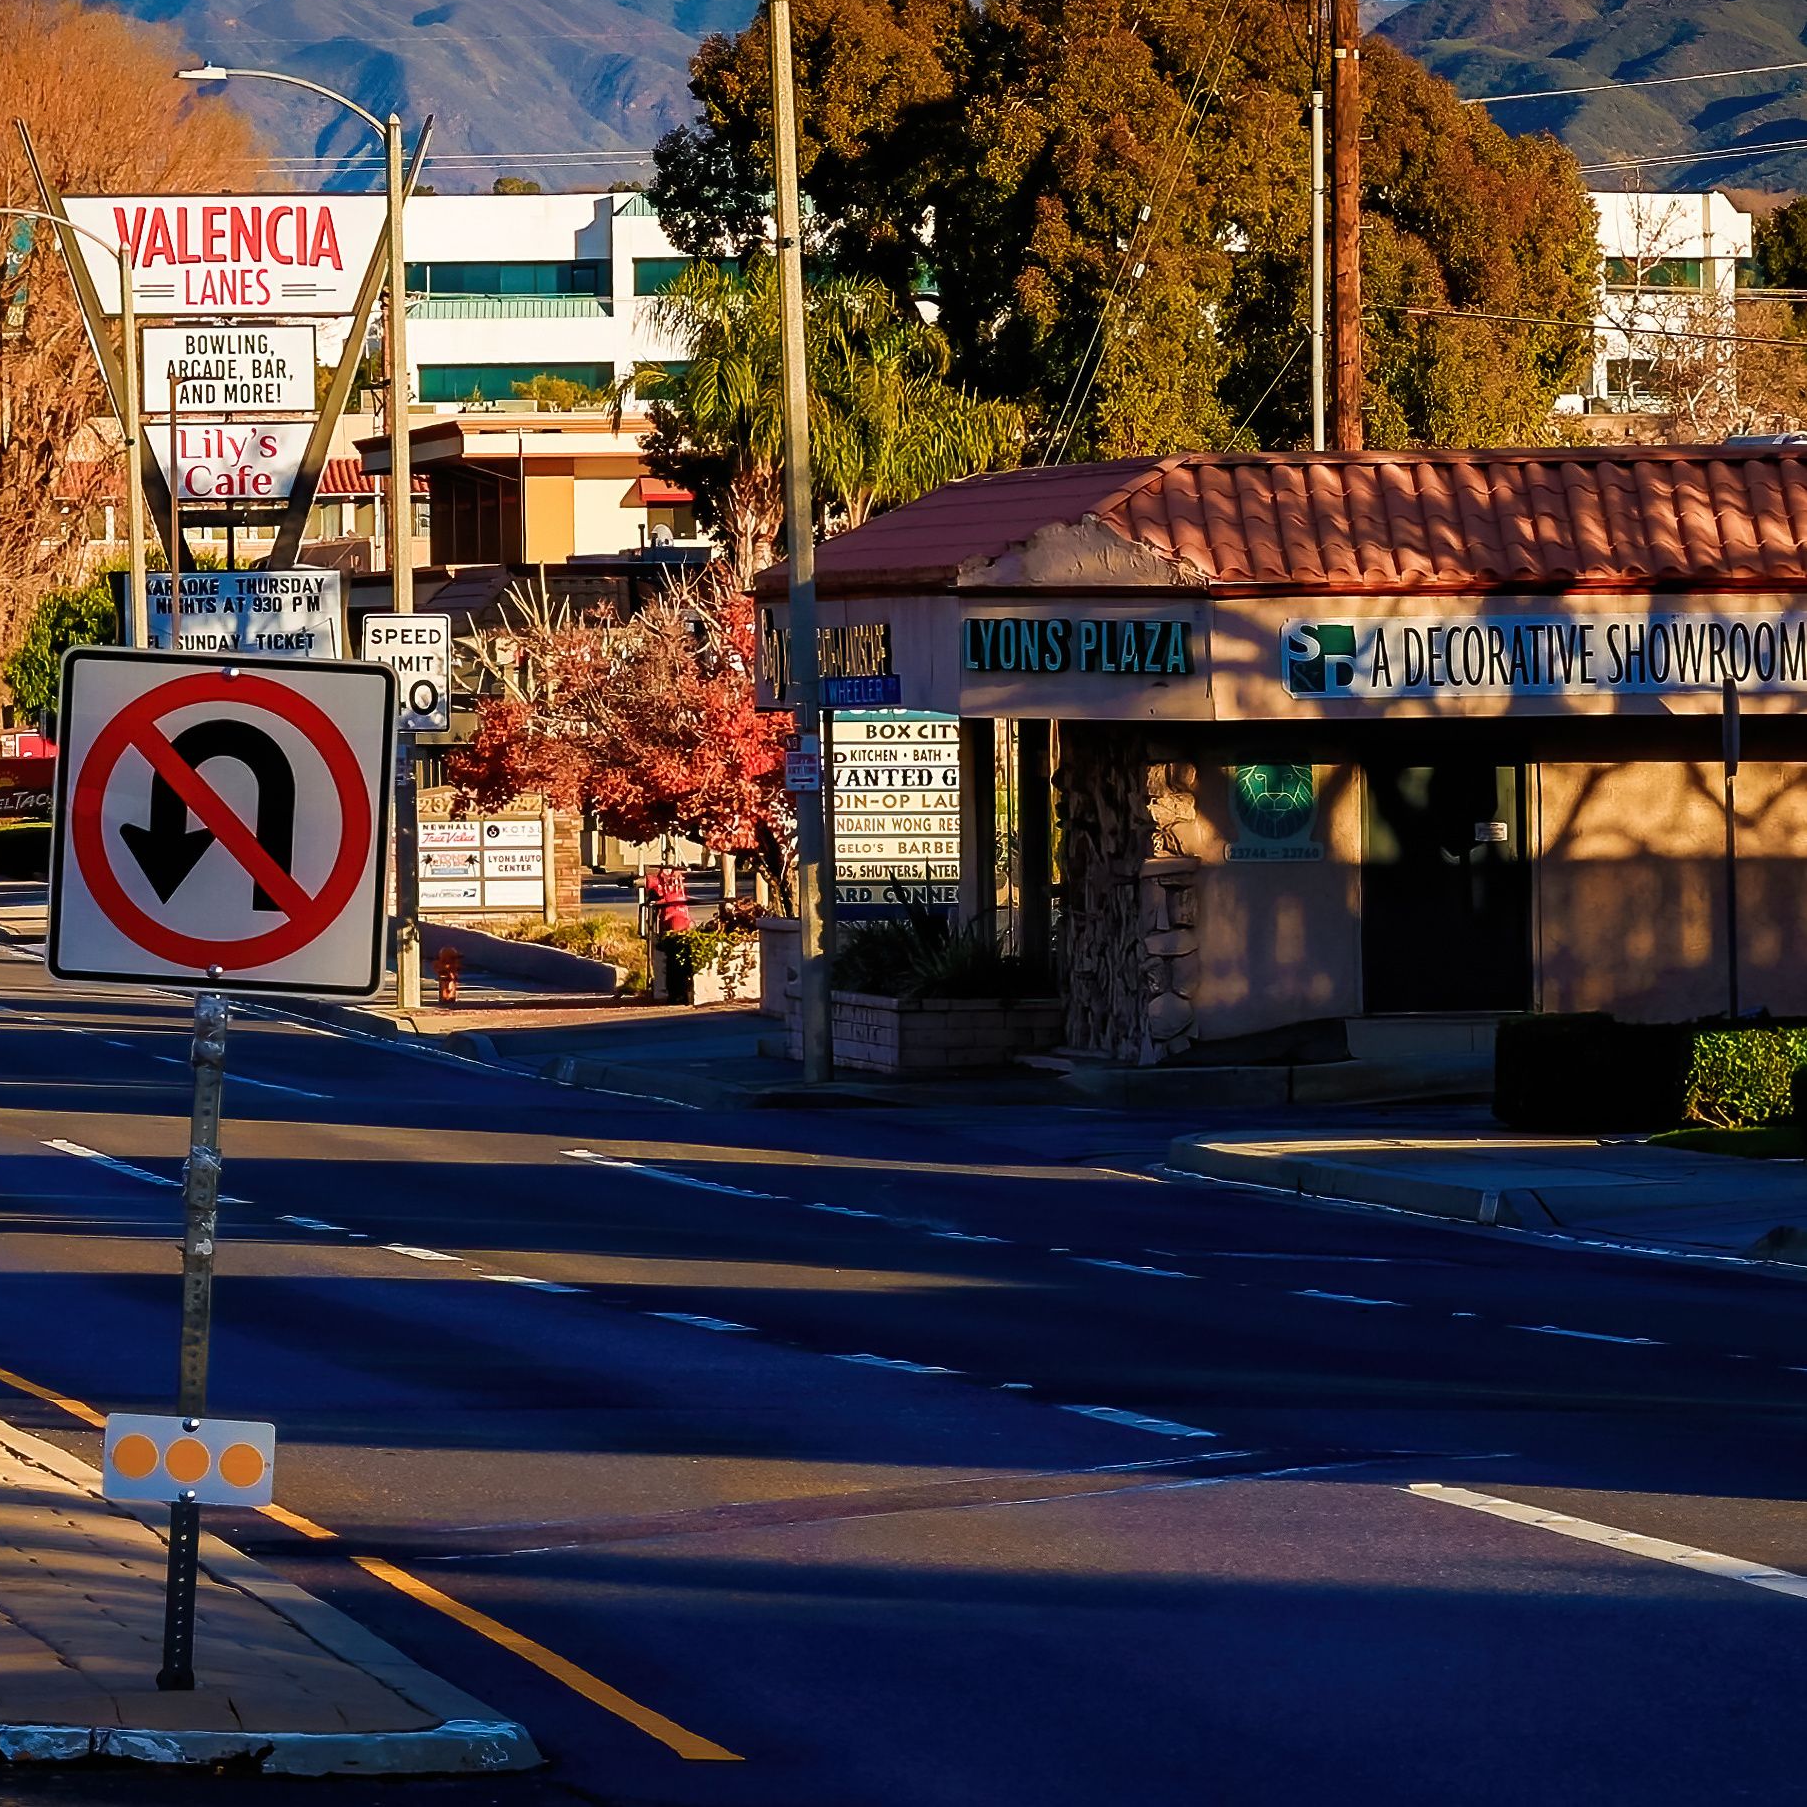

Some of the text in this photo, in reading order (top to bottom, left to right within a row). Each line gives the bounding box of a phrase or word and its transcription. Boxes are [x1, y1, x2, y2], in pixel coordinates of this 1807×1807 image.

[113, 205, 344, 271] VALENCIA
[185, 268, 271, 306] LANES
[186, 334, 275, 357] BOWLING,
[167, 358, 294, 381] ARCADE, BAR,
[179, 383, 281, 404] AND MORE!
[176, 427, 278, 467] Lily's
[185, 465, 273, 497] Cafe
[236, 577, 325, 595] THURSDAY
[156, 596, 217, 614] NIHTS
[223, 597, 246, 614] AT
[252, 596, 283, 613] 930
[177, 634, 241, 652] SUNDAY
[256, 633, 316, 650] TICKET
[370, 627, 442, 645] SPEED
[964, 618, 1187, 673] LYONS PLAZA
[377, 655, 434, 672] IMIT
[1370, 620, 1807, 688] A DECORATIVE SHOWROOM
[399, 679, 439, 716] 0
[828, 679, 884, 704] WHEELER
[866, 724, 911, 739] BOX
[850, 749, 898, 762] KITCHEN
[913, 749, 942, 762] BATH
[836, 818, 886, 832] NDARIN
[892, 817, 932, 832] WONG
[898, 841, 960, 854] BARBE
[488, 854, 542, 864] LYONS AUTO
[498, 864, 532, 872] CENTER
[860, 864, 924, 879] SHUTTERS,
[927, 864, 959, 878] NTER
